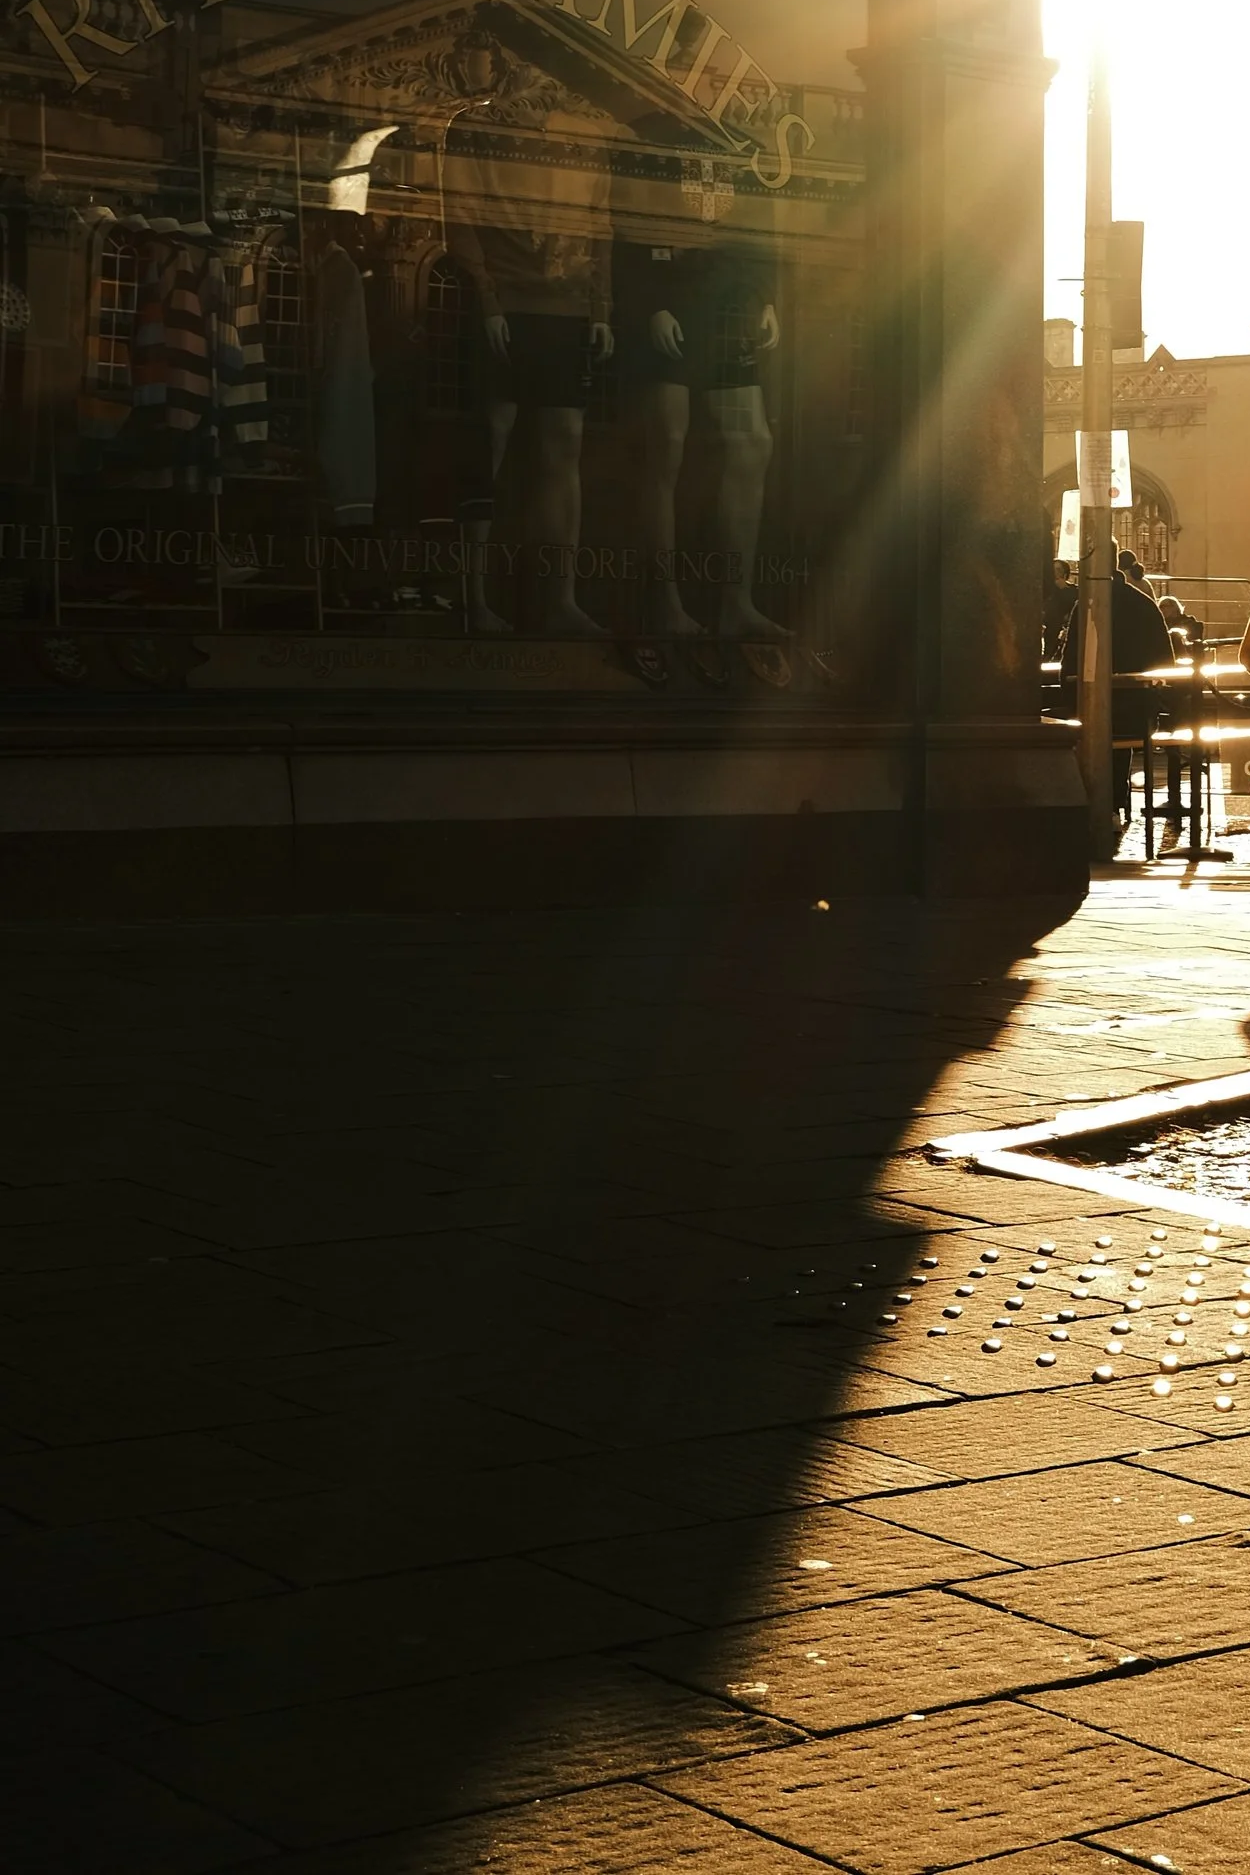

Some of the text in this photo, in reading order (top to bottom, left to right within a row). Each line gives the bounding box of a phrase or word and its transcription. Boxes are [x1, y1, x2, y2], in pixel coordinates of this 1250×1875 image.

[0, 523, 74, 563] THE
[93, 527, 285, 569] ORIGINAL
[303, 536, 522, 578] UNIVERSITY
[537, 544, 640, 581] STORE
[654, 549, 743, 584] SINCE
